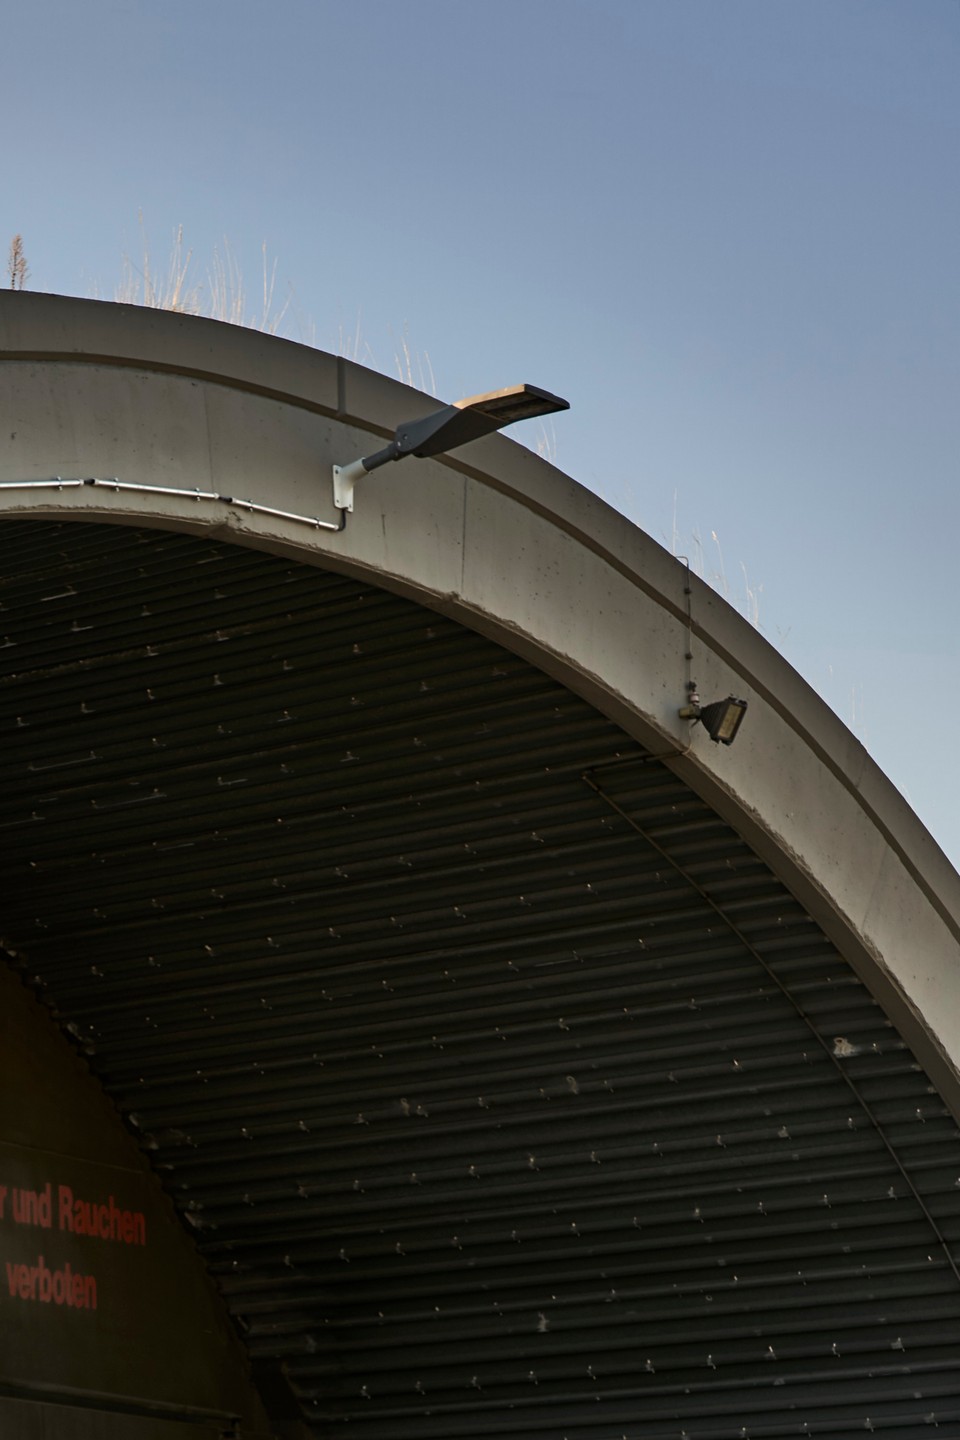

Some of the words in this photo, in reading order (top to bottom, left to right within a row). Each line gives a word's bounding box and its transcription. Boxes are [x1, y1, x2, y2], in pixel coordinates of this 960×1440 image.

[12, 1182, 53, 1229] und
[58, 1184, 146, 1246] Rauchen
[5, 1254, 98, 1310] verboten
